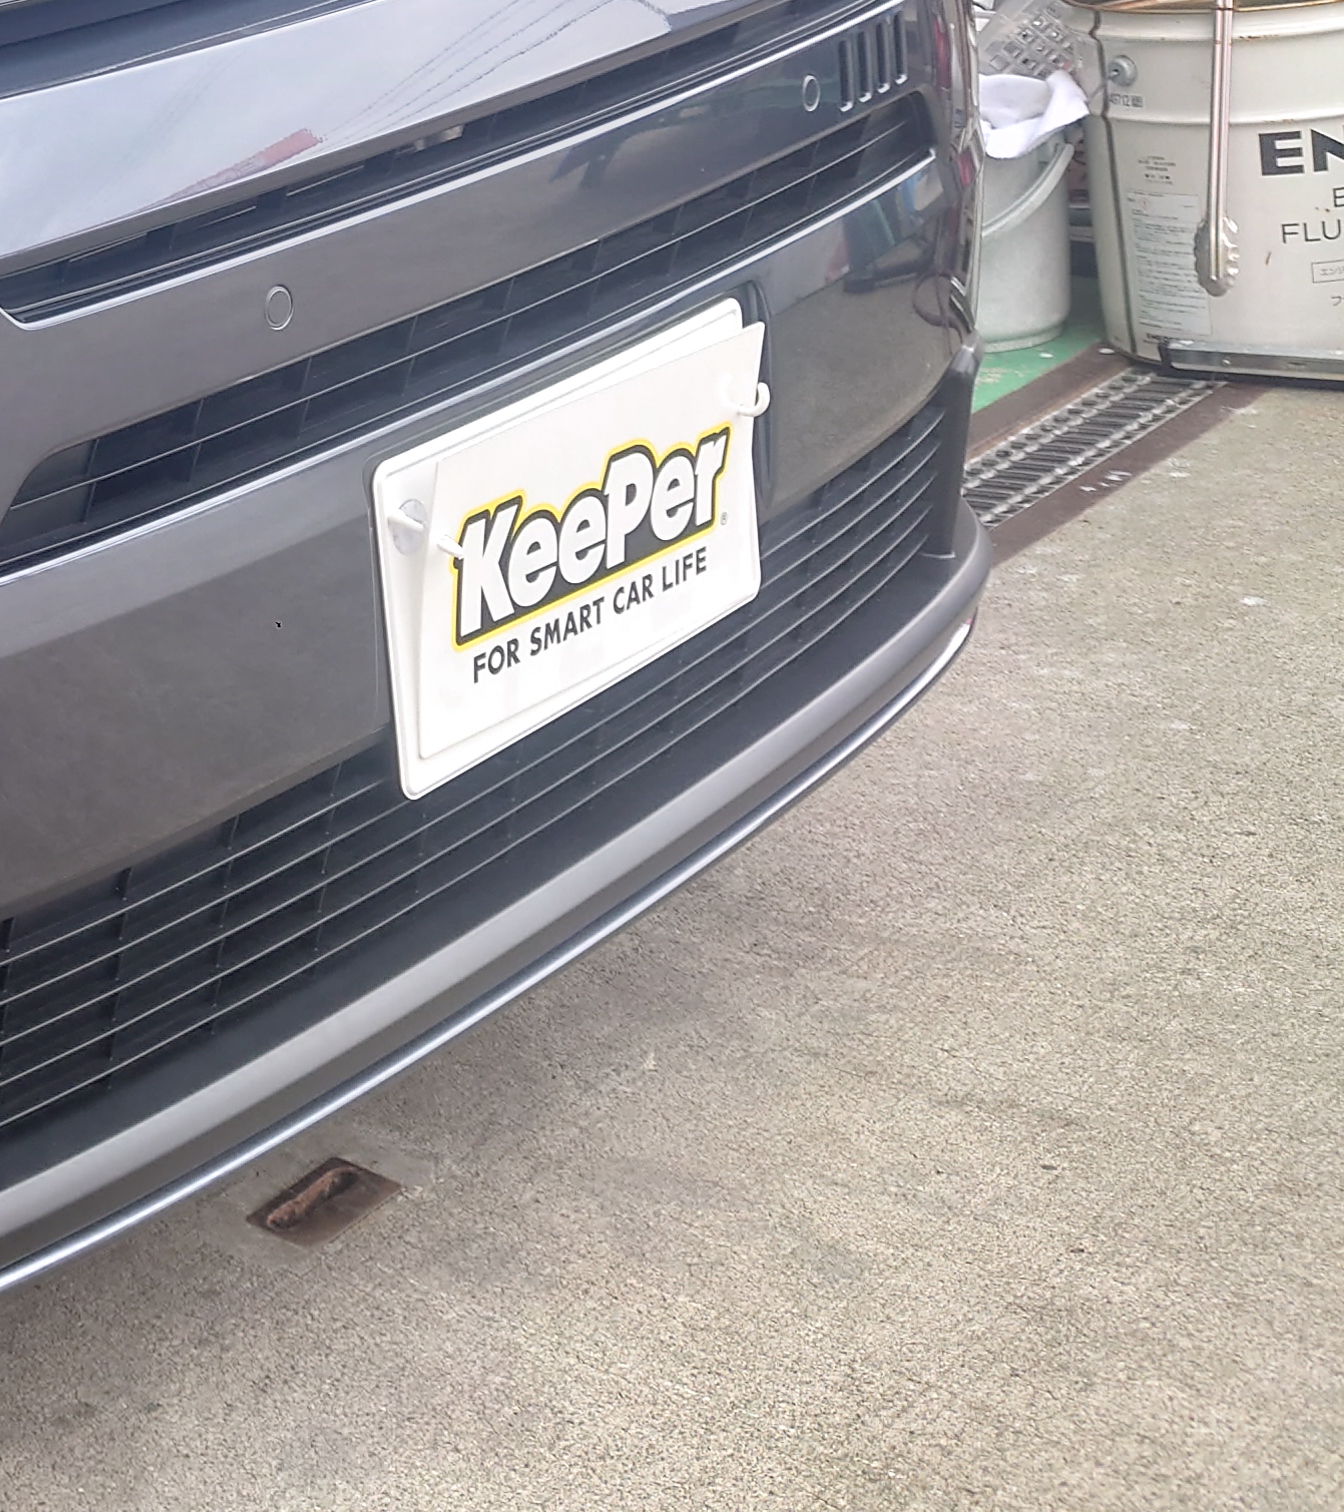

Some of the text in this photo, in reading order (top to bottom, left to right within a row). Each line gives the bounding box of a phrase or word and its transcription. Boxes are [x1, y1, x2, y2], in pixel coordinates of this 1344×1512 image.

[453, 426, 731, 647] KeePer
[473, 546, 707, 684] FOR SMART CAR LIFE
